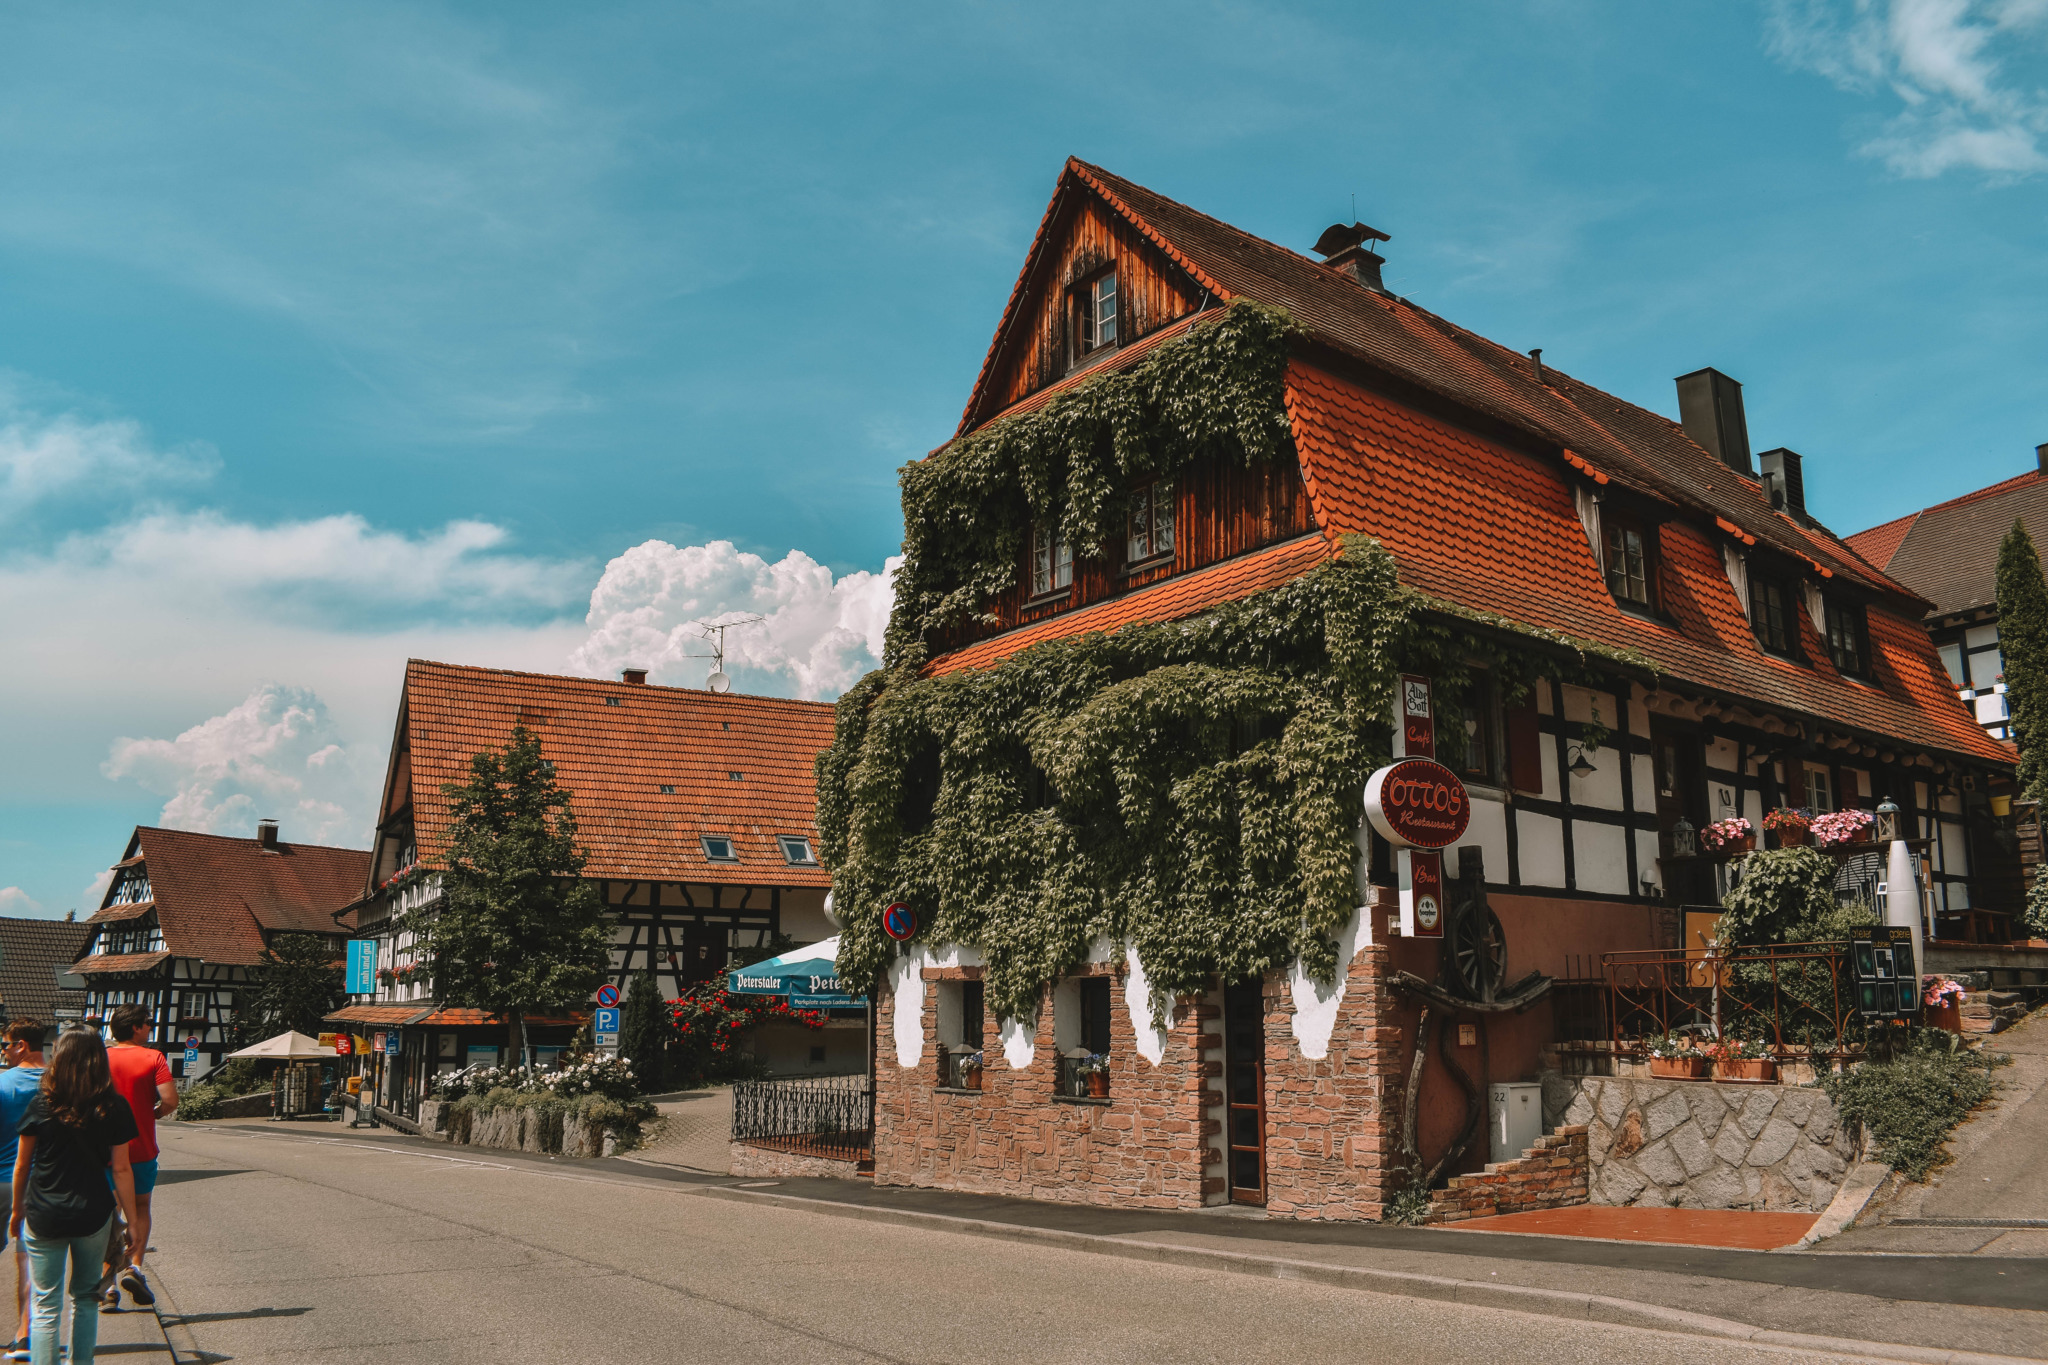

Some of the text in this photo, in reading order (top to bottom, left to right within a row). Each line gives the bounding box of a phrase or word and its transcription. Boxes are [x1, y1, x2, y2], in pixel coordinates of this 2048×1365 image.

[1408, 683, 1428, 700] Alde
[1407, 698, 1428, 712] Gott
[1407, 725, 1430, 748] Café
[1400, 809, 1456, 831] Restaurant
[1415, 864, 1438, 884] Bar
[1889, 928, 1911, 941] galerie
[362, 942, 372, 955] gut
[361, 955, 371, 970] und
[737, 973, 781, 991] Peterstaler
[808, 974, 841, 993] Pete
[794, 998, 819, 1006] Parkplatz
[599, 1011, 612, 1030] P
[387, 1031, 395, 1041] P
[186, 1050, 195, 1060] P
[1494, 1092, 1505, 1102] 22
